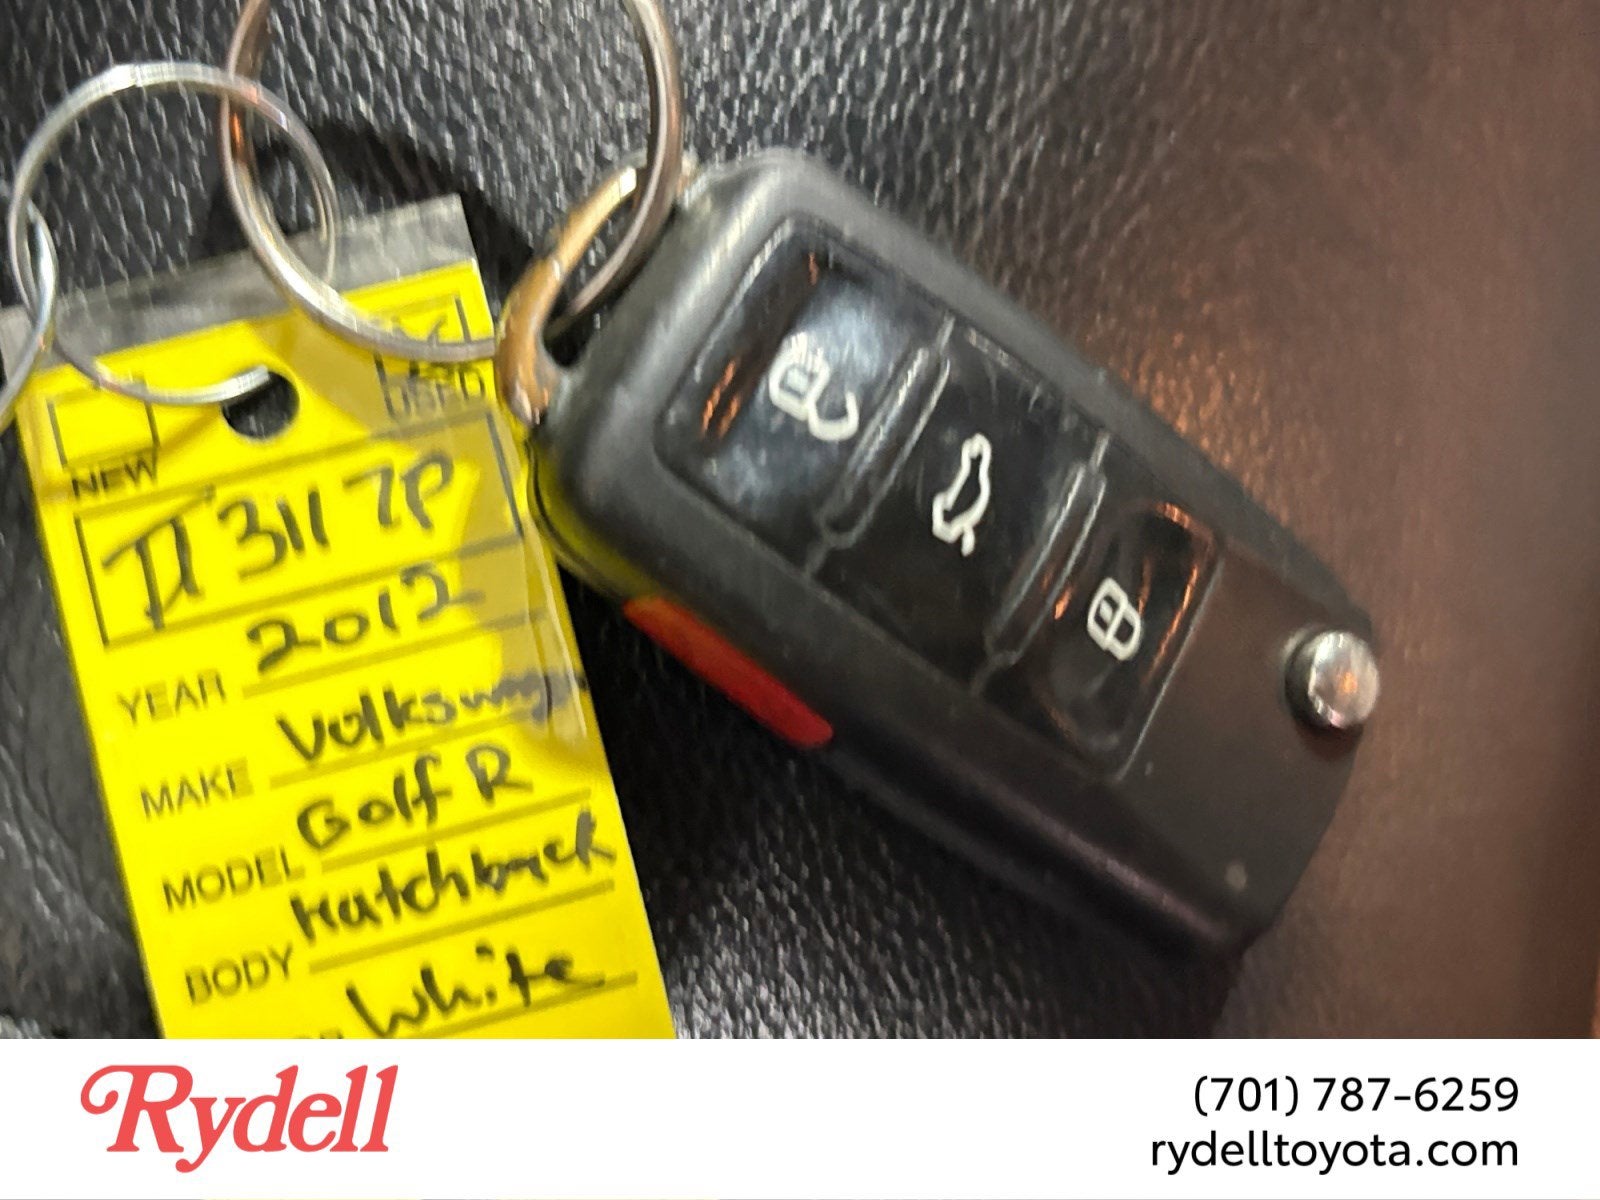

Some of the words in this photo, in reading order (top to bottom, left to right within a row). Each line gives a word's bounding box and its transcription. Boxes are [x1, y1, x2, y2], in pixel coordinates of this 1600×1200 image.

[72, 457, 159, 499] NEW
[246, 562, 484, 674] 2012
[118, 670, 227, 727] YEAR
[140, 758, 253, 821] MAKE
[297, 751, 452, 850] Golf
[464, 742, 535, 805] R
[162, 845, 305, 913] MODEL
[185, 942, 295, 1006] BODY
[346, 944, 606, 1038] White
